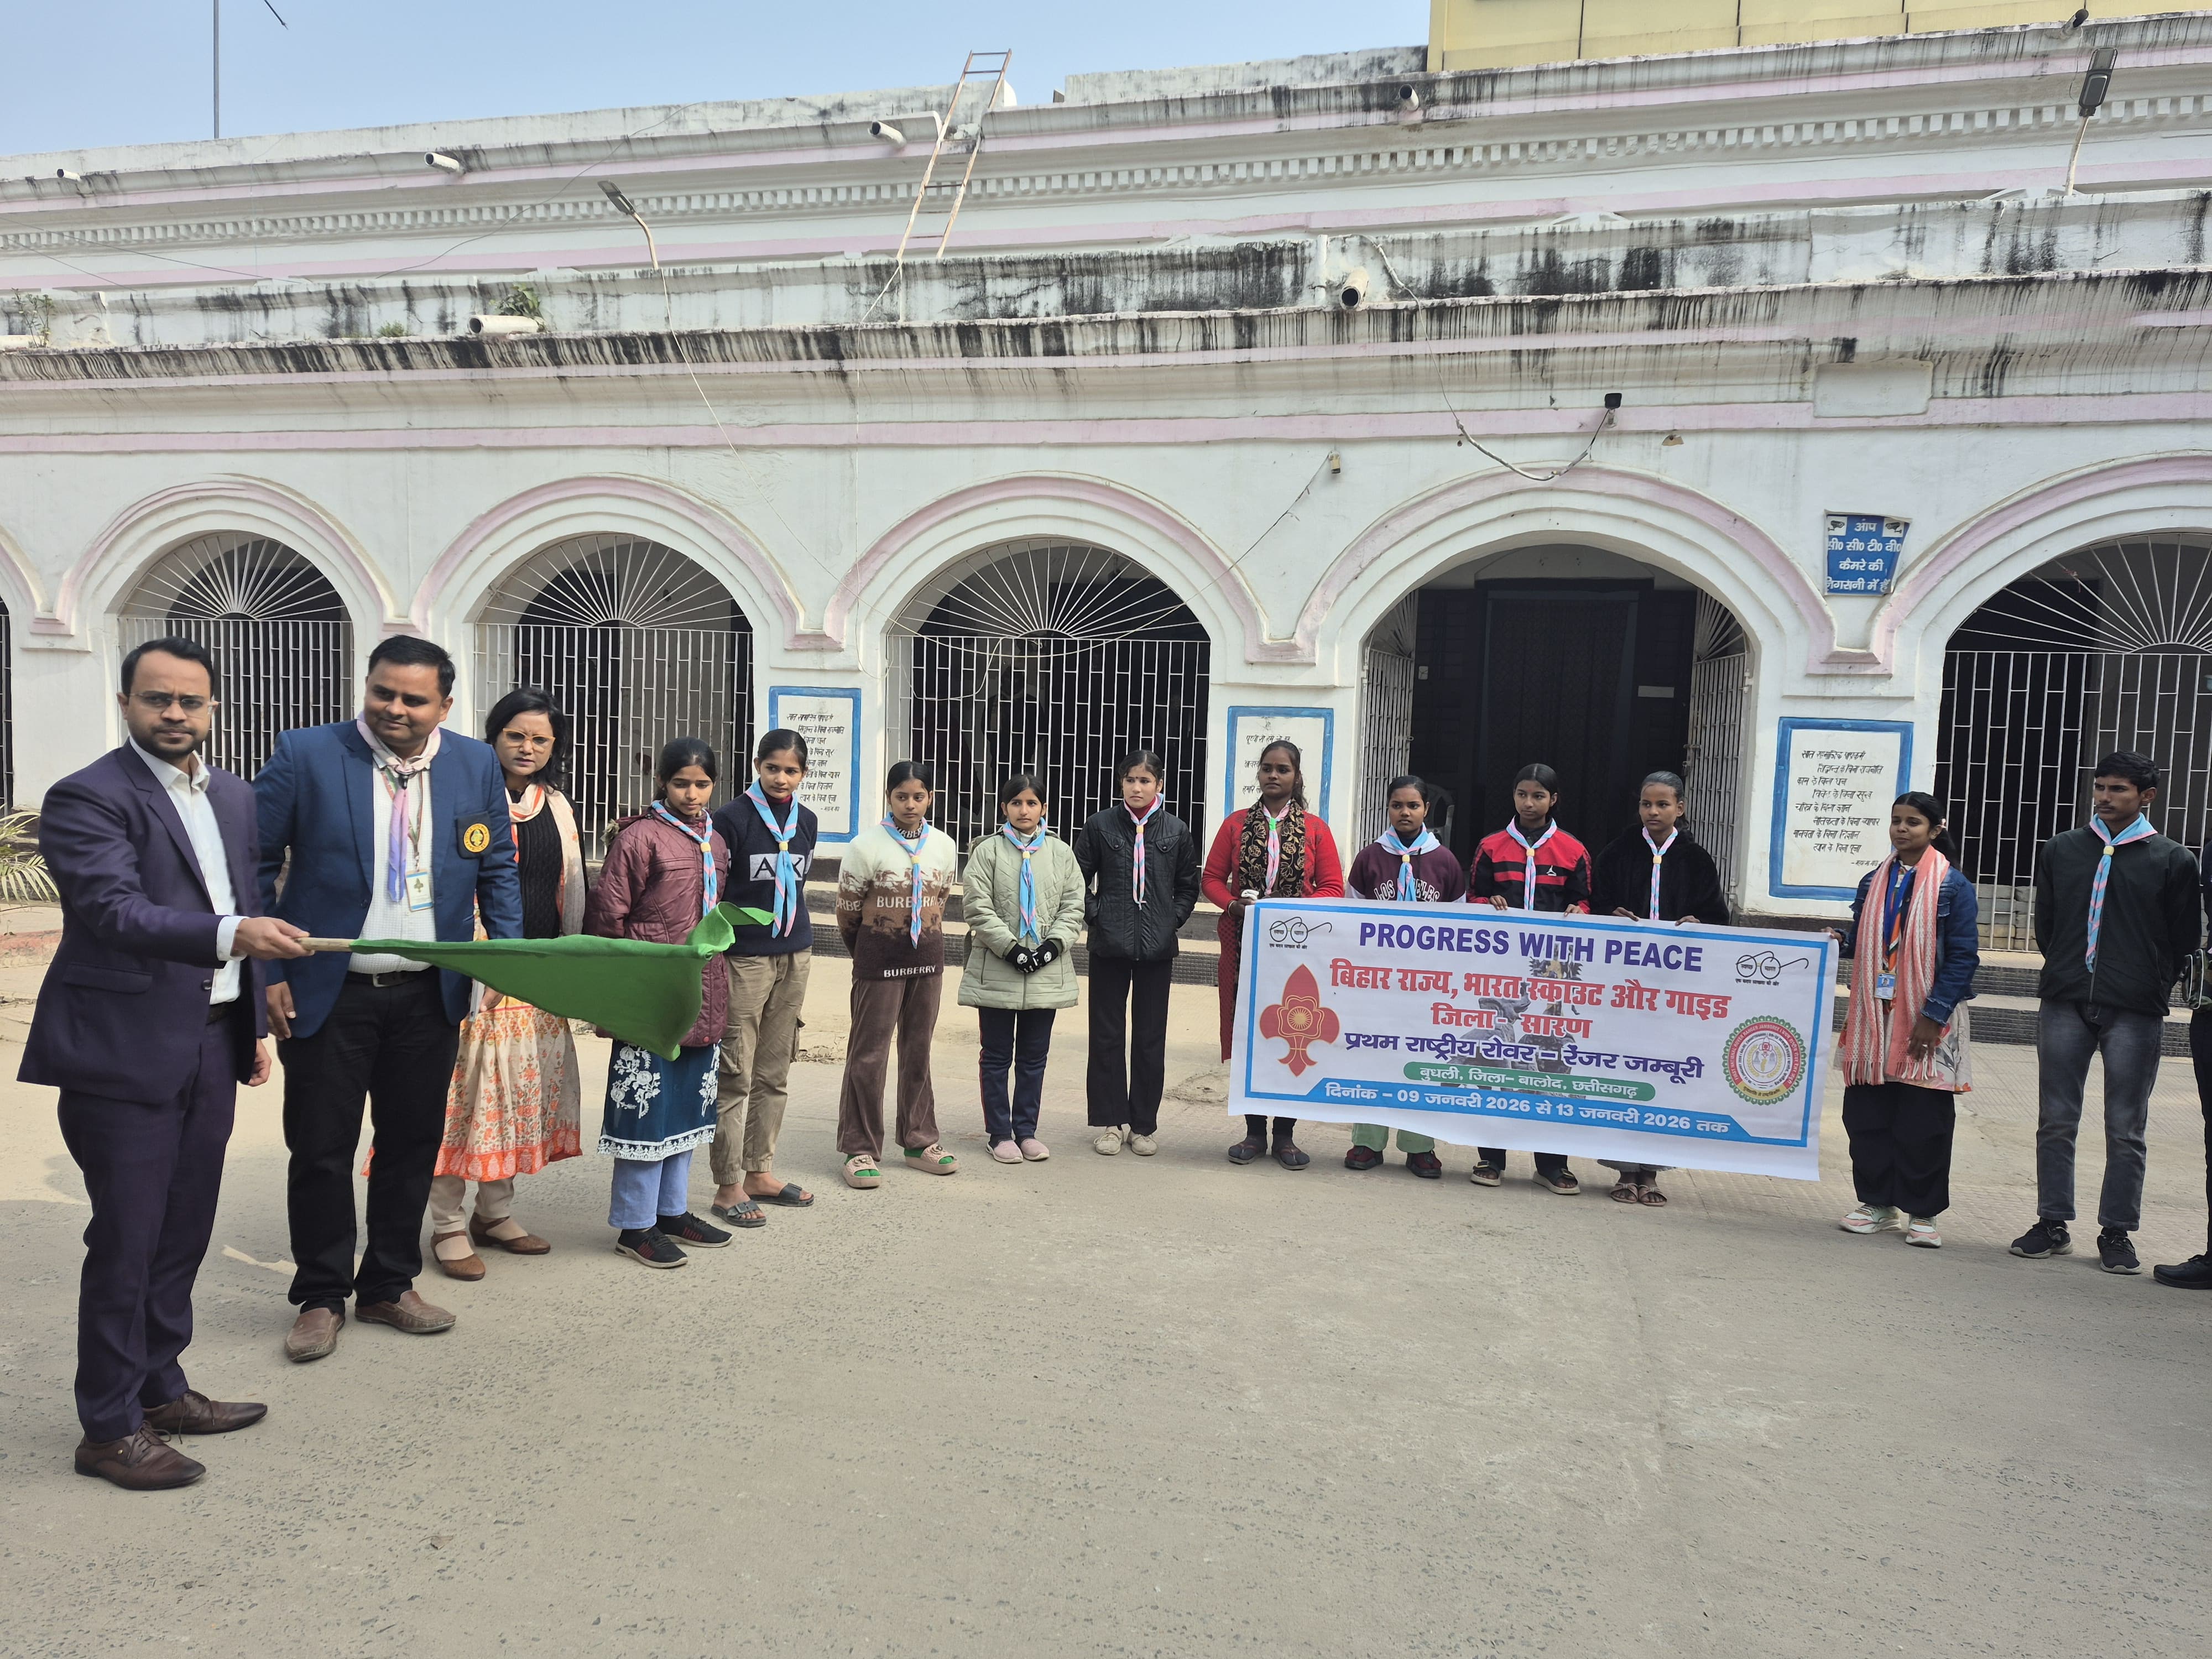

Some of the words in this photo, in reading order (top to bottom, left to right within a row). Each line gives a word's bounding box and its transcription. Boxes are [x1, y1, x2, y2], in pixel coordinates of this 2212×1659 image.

[1839, 557, 1867, 571] कैमरे
[1868, 559, 1885, 571] की
[1867, 578, 1880, 591] में
[1374, 880, 1395, 900] LOS
[1359, 922, 1509, 955] PROGRESS
[1519, 932, 1594, 962] WITH
[1604, 940, 1703, 972] PEACE
[884, 965, 936, 978] BURBERRY
[1330, 958, 1392, 990] बिहार
[1396, 969, 1459, 999] राज्य,
[1464, 972, 1522, 999] भारत
[1526, 977, 1605, 1006] स्काउट
[1610, 979, 1660, 1011] और
[1665, 990, 1732, 1021] गाइड
[1520, 1013, 1593, 1039] सारण
[1344, 1032, 1400, 1050] प्रथम
[1405, 1033, 1476, 1061] राष्ट्रीय
[1482, 1037, 1536, 1061] रोवर
[1563, 1044, 1619, 1069] रेंजर
[1624, 1056, 1705, 1084] जम्बूरी
[1519, 1076, 1567, 1091] बालोद,
[1572, 1081, 1639, 1099] छत्तीसगढ़
[1325, 1082, 1379, 1100] दिनांक
[1397, 1089, 1420, 1102] 09
[1424, 1092, 1482, 1108] जनवरी
[1486, 1097, 1530, 1112] 2026
[1535, 1100, 1551, 1115] से
[1556, 1103, 1574, 1117] 13
[1579, 1107, 1640, 1124] जनवरी
[1644, 1113, 1691, 1129] 2026
[1696, 1120, 1730, 1134] तक
